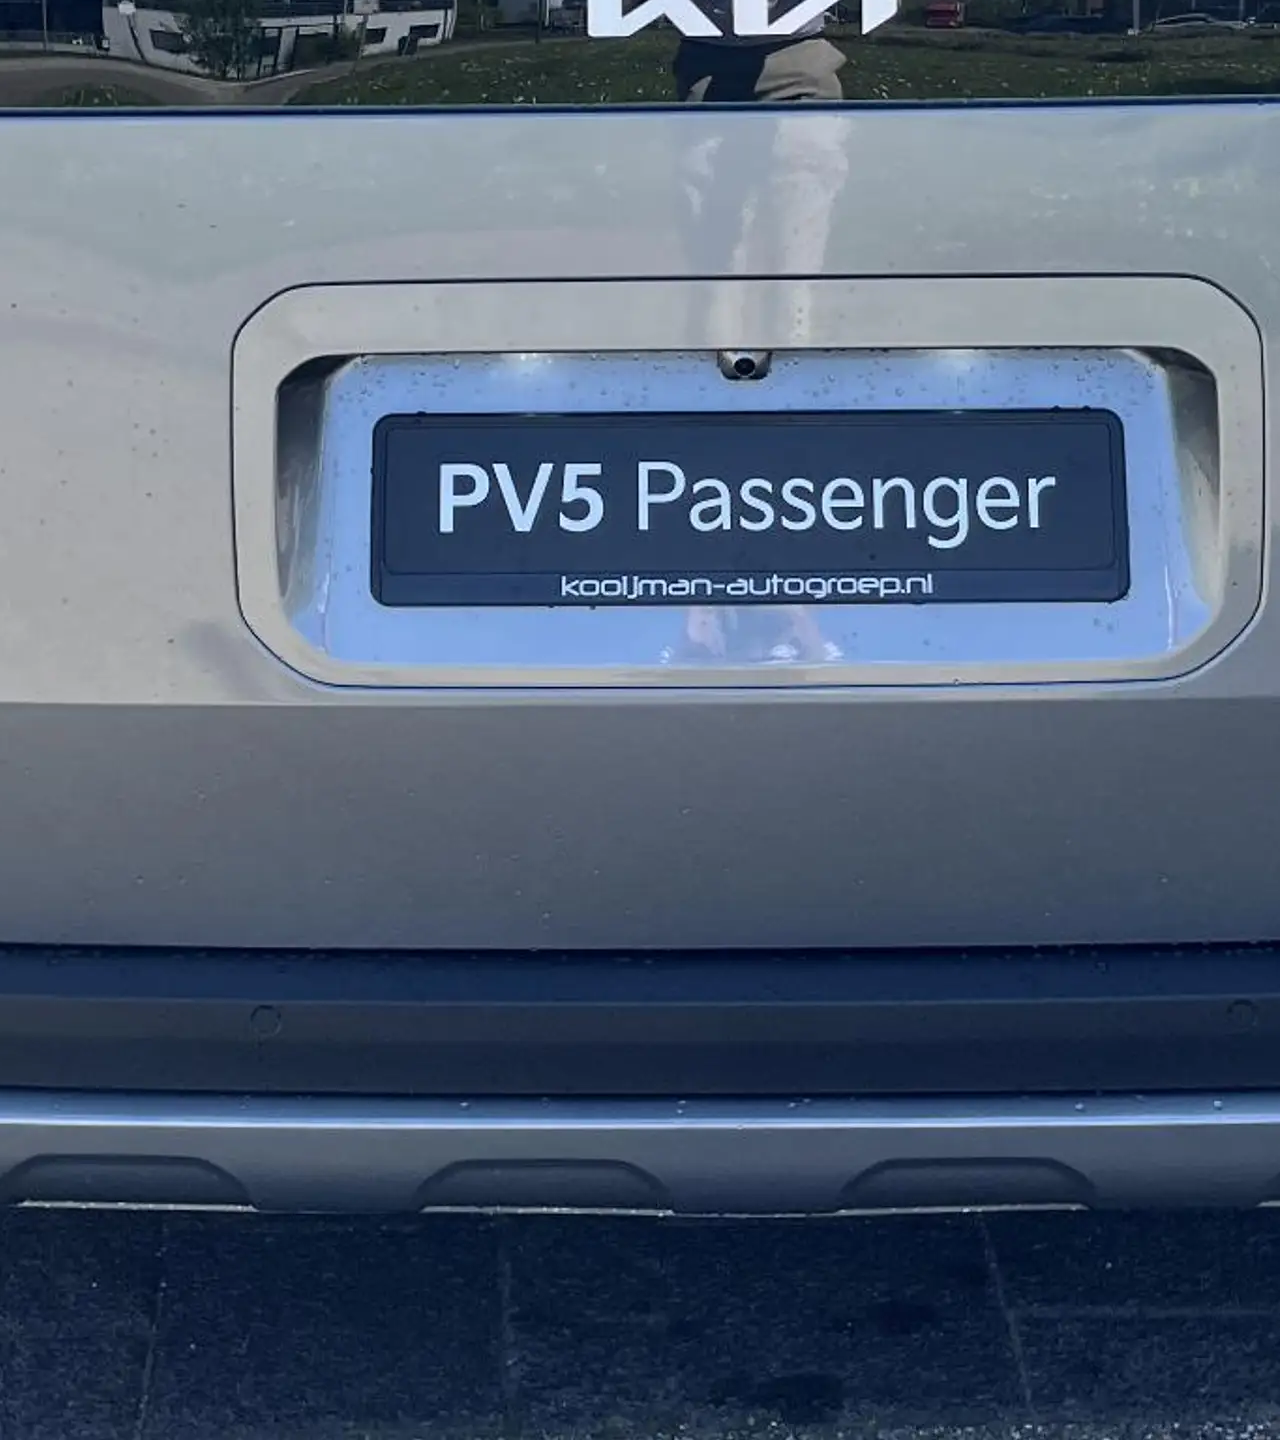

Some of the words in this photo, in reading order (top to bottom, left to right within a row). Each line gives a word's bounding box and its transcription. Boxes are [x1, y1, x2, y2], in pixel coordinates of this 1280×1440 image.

[438, 462, 604, 533] PV5
[637, 460, 1056, 549] Passenger
[560, 573, 934, 600] kooijman-autogroep.nl
